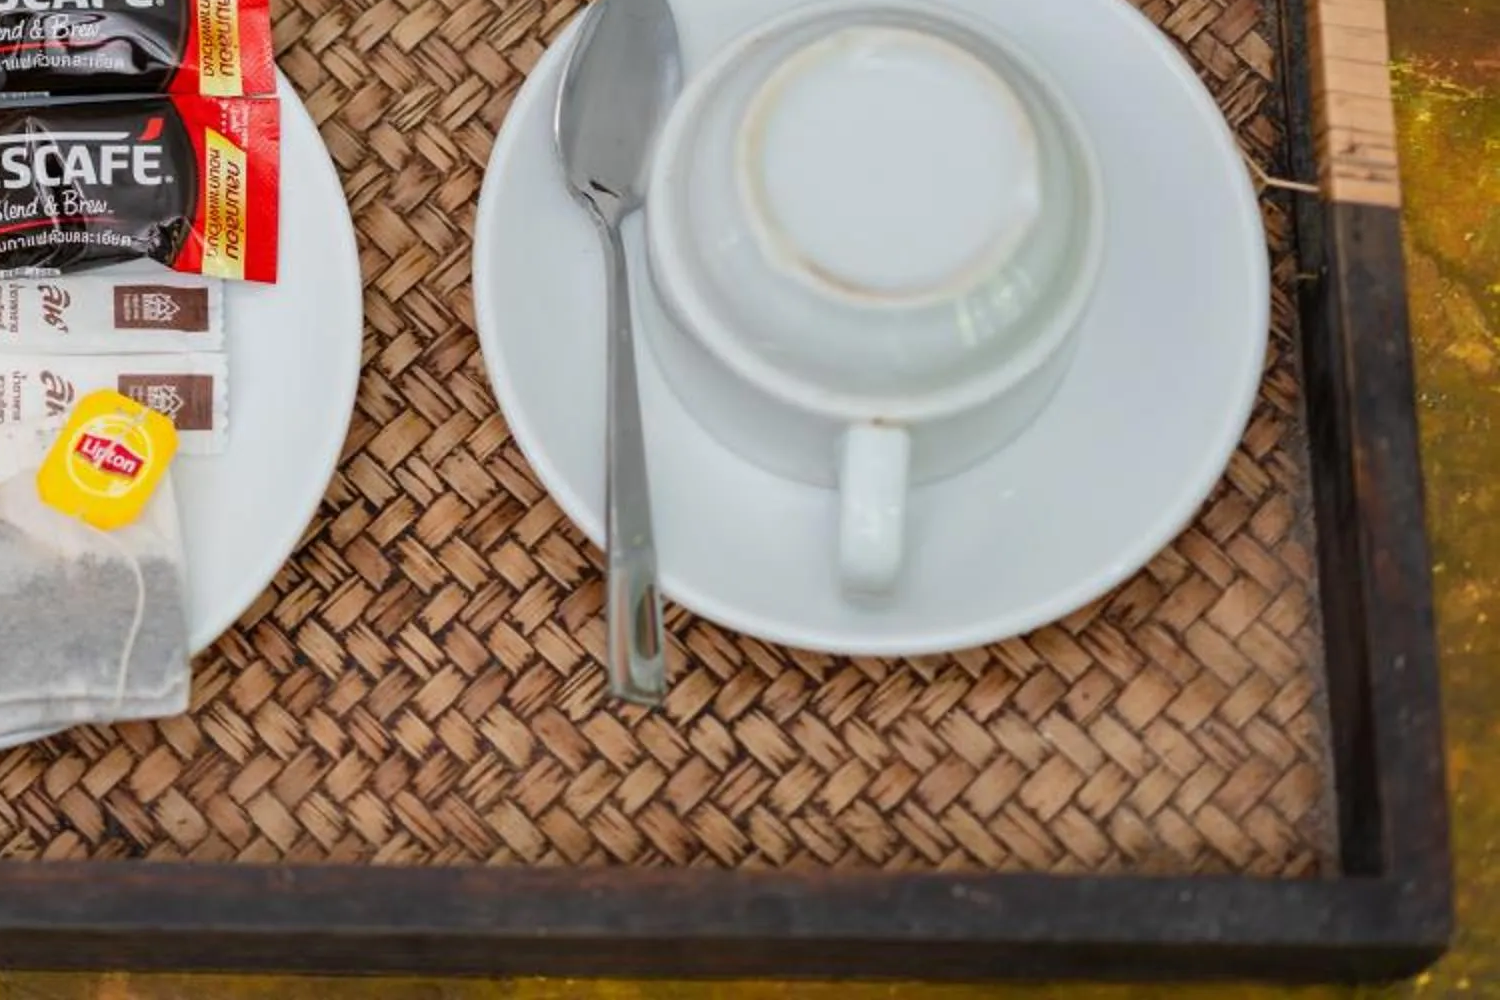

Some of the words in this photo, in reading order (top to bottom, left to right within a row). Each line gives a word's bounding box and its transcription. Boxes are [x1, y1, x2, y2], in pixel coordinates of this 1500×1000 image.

[30, 20, 45, 40] &
[50, 14, 100, 40] Brew
[44, 198, 59, 217] &
